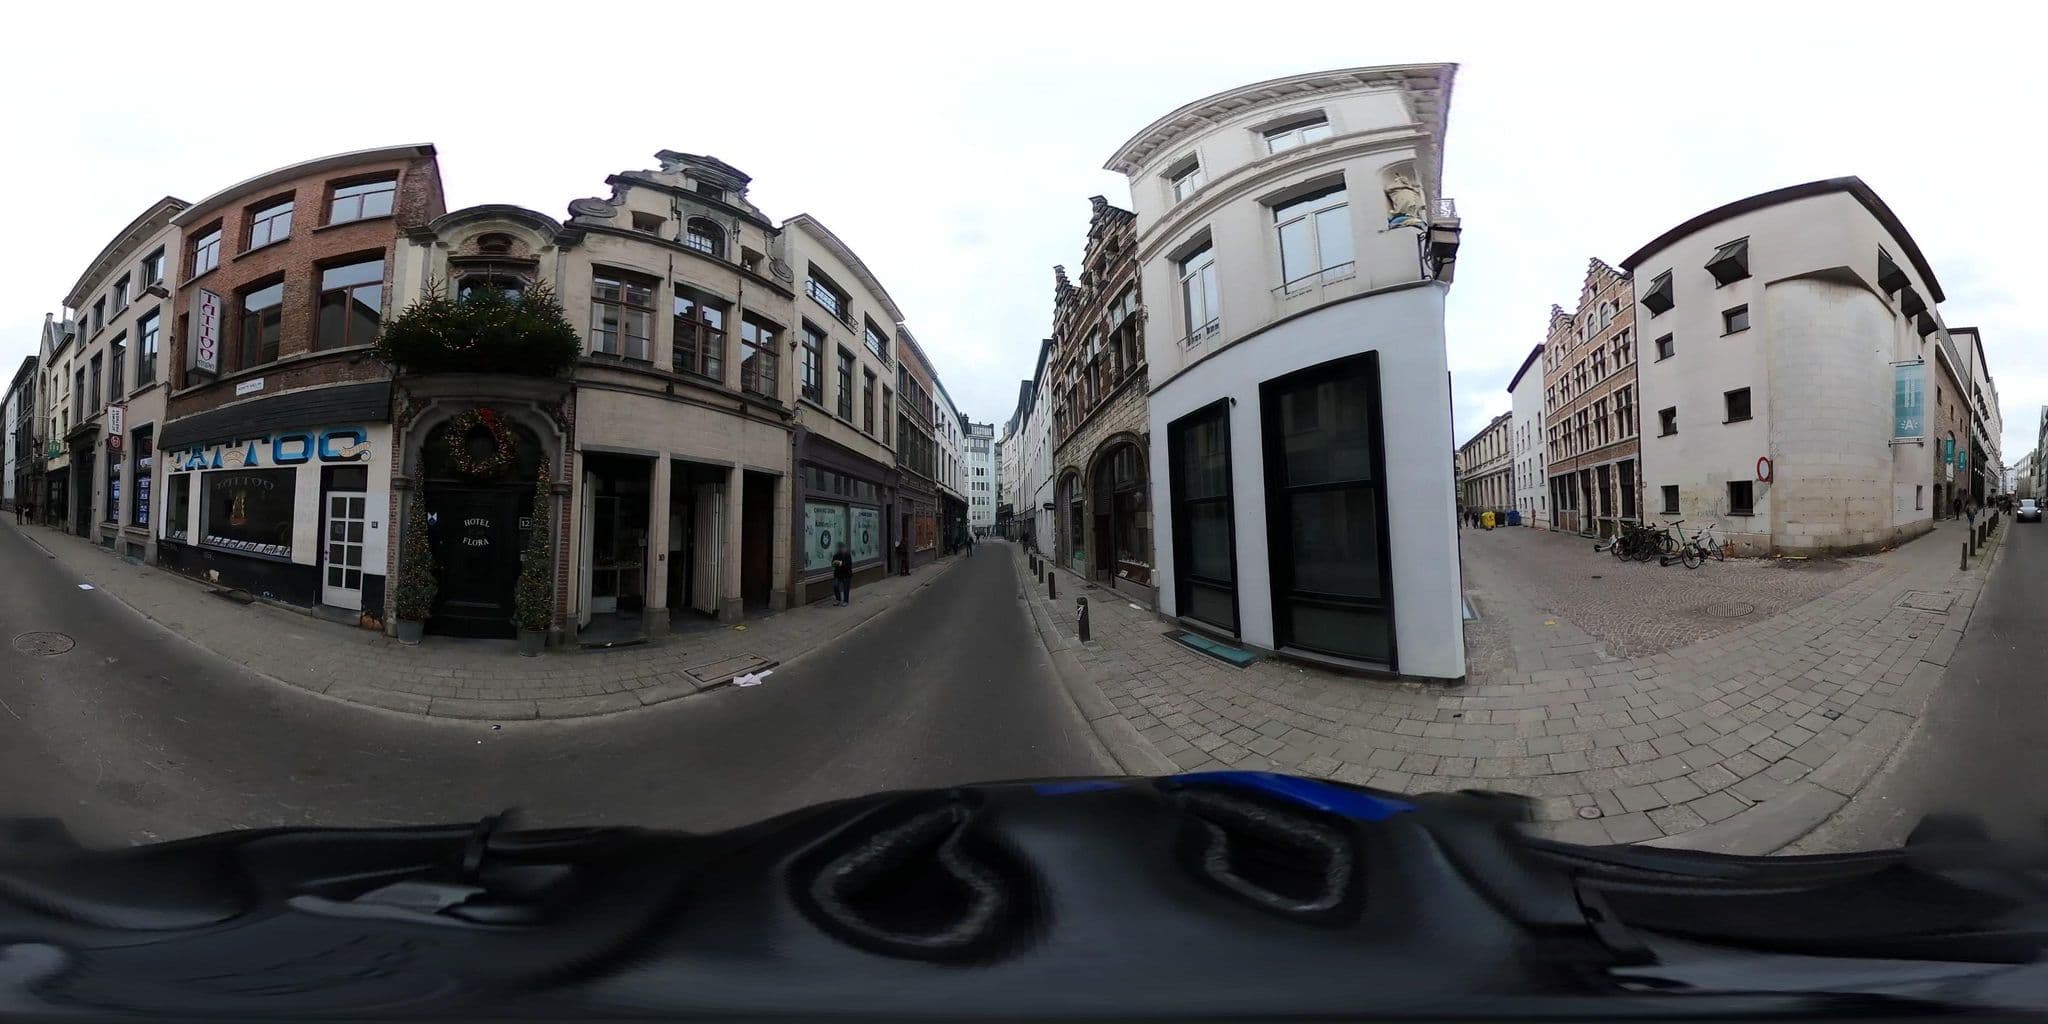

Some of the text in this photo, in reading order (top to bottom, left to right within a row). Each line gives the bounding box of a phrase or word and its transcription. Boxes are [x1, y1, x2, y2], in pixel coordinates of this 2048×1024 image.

[200, 292, 216, 360] TATTOO
[464, 518, 490, 528] HOTEL
[462, 536, 490, 546] FLORA
